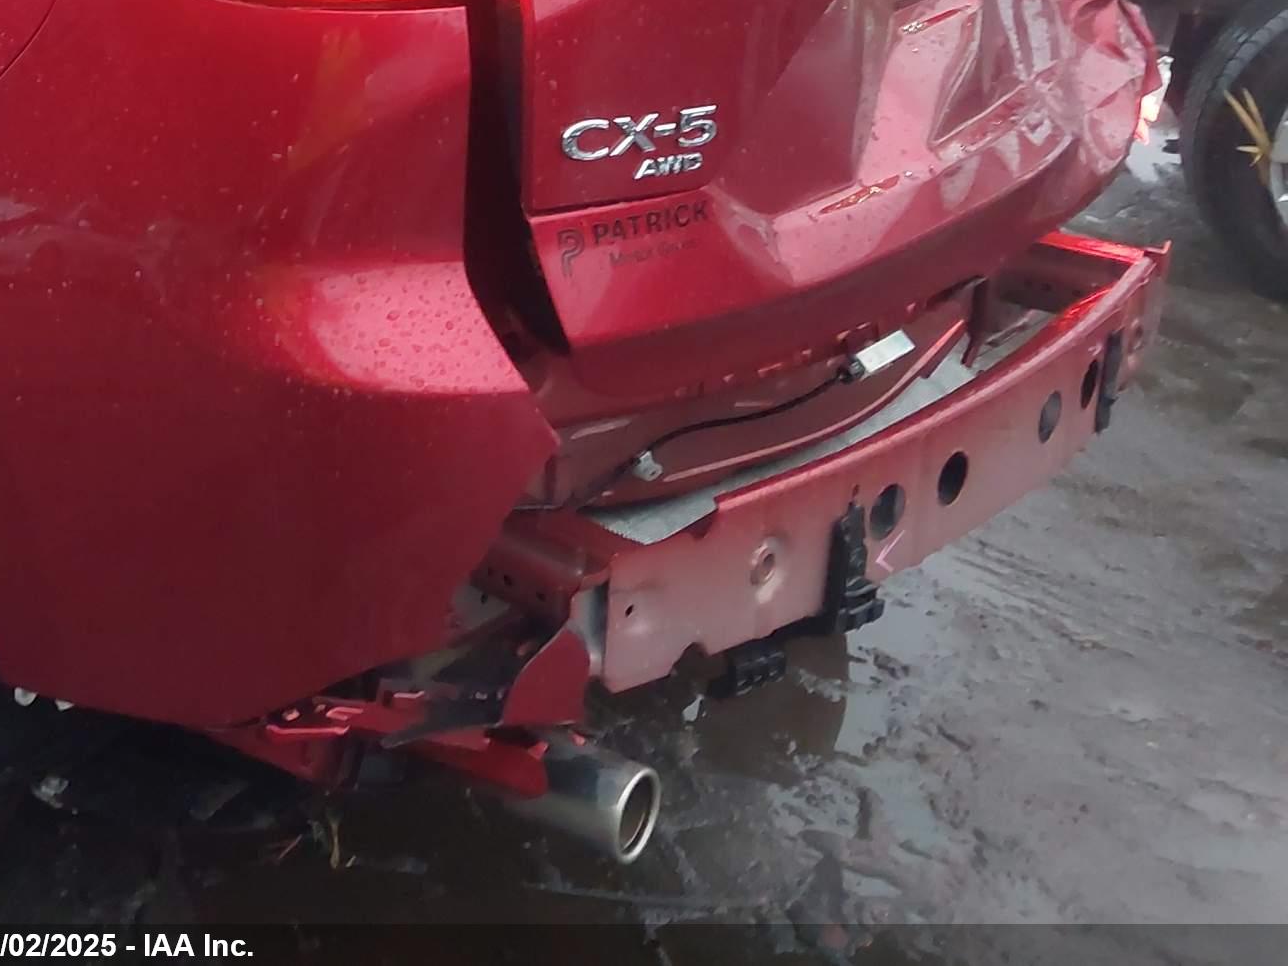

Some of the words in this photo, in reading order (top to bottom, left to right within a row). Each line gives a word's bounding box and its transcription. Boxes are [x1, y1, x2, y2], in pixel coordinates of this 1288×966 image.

[561, 104, 719, 162] CX-5
[633, 152, 703, 179] AWD
[593, 200, 708, 245] PATRICK
